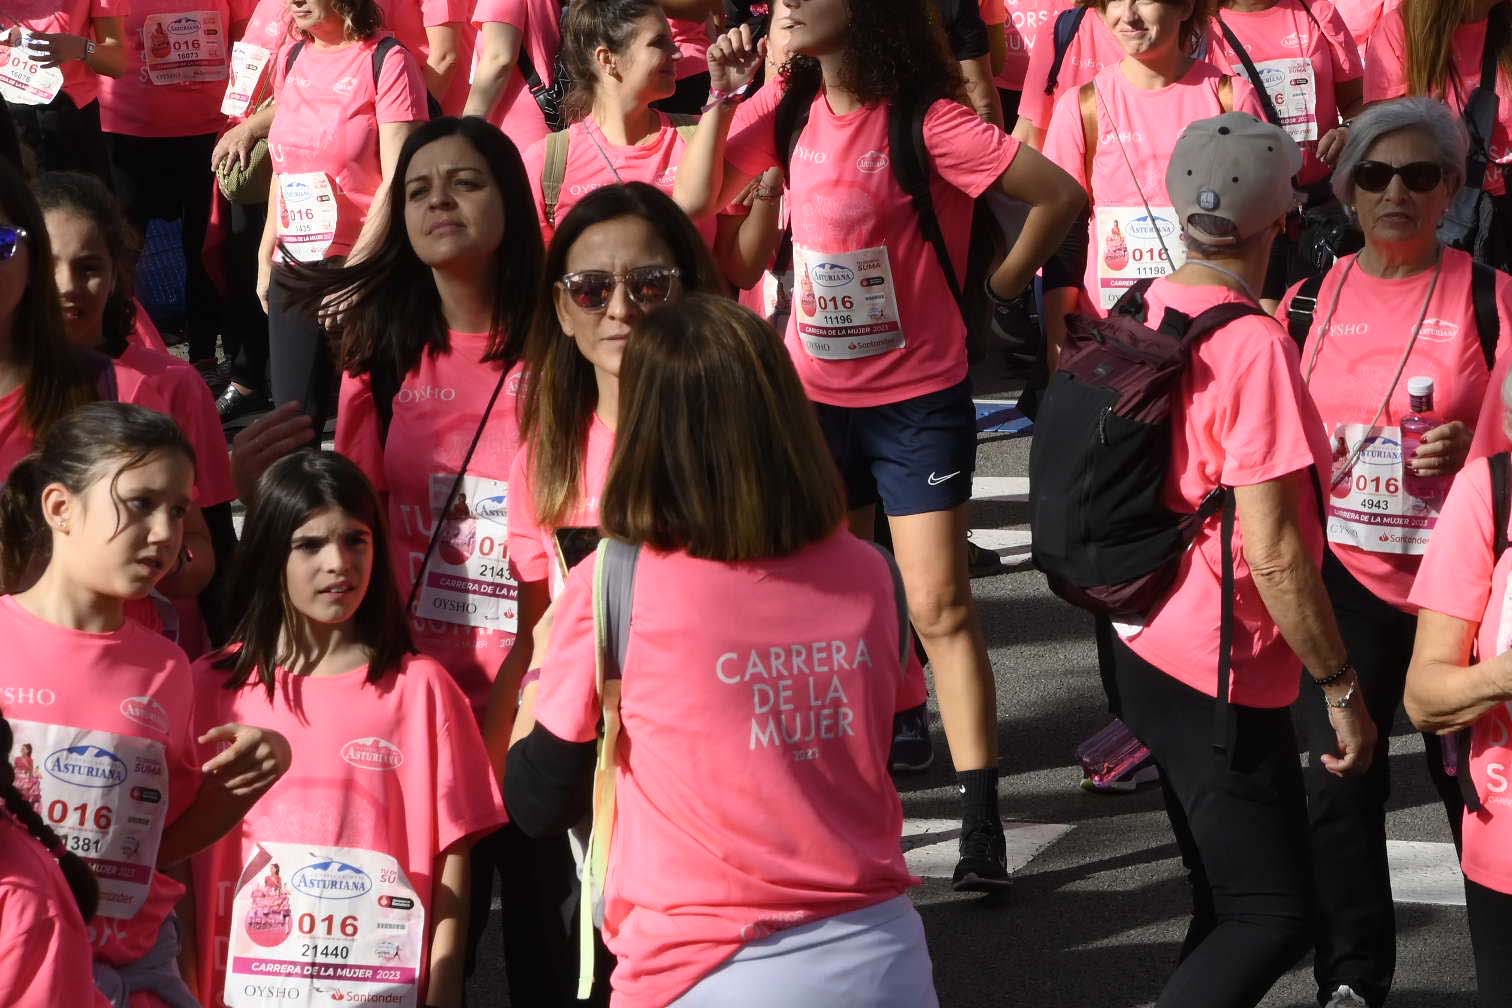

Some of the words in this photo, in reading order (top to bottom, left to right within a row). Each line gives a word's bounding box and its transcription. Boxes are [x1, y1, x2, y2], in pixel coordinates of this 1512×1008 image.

[172, 39, 201, 51] 016
[11, 57, 38, 74] 016
[290, 208, 314, 222] 016
[1132, 247, 1170, 262] 016
[857, 262, 881, 272] SUMA
[1137, 266, 1166, 275] 11198
[818, 295, 854, 310] 016
[824, 314, 853, 325] 11196
[847, 327, 870, 335] MUJER
[398, 387, 456, 403] OYSHO
[1355, 474, 1399, 495] 016
[1361, 498, 1389, 511] 4943
[1361, 514, 1370, 522] DE
[1370, 515, 1382, 524] LA
[1382, 515, 1410, 526] MUJER
[479, 536, 508, 558] 01
[480, 564, 516, 581] 2143
[480, 584, 494, 593] DE
[496, 586, 508, 595] LA
[433, 597, 477, 614] OYSHO
[716, 638, 873, 684] CARRERA
[0, 687, 56, 706] SHO
[752, 679, 795, 714] DE
[808, 674, 849, 706] LA
[750, 707, 856, 751] MUJER
[346, 748, 401, 767] ASTURIANA
[50, 756, 123, 783] ASTURIANA
[47, 799, 113, 831] 016
[63, 834, 102, 855] 1381
[297, 873, 367, 893] ASTURIANA
[379, 874, 396, 885] SU
[298, 912, 359, 938] 016
[301, 943, 349, 960] 21440
[252, 961, 301, 975] CARRERA
[303, 965, 319, 976] DE
[320, 966, 334, 977] LA
[336, 967, 373, 979] MUJER
[376, 969, 401, 980] 2023
[244, 983, 300, 1000] OYSHO
[346, 990, 404, 1004] Santander
